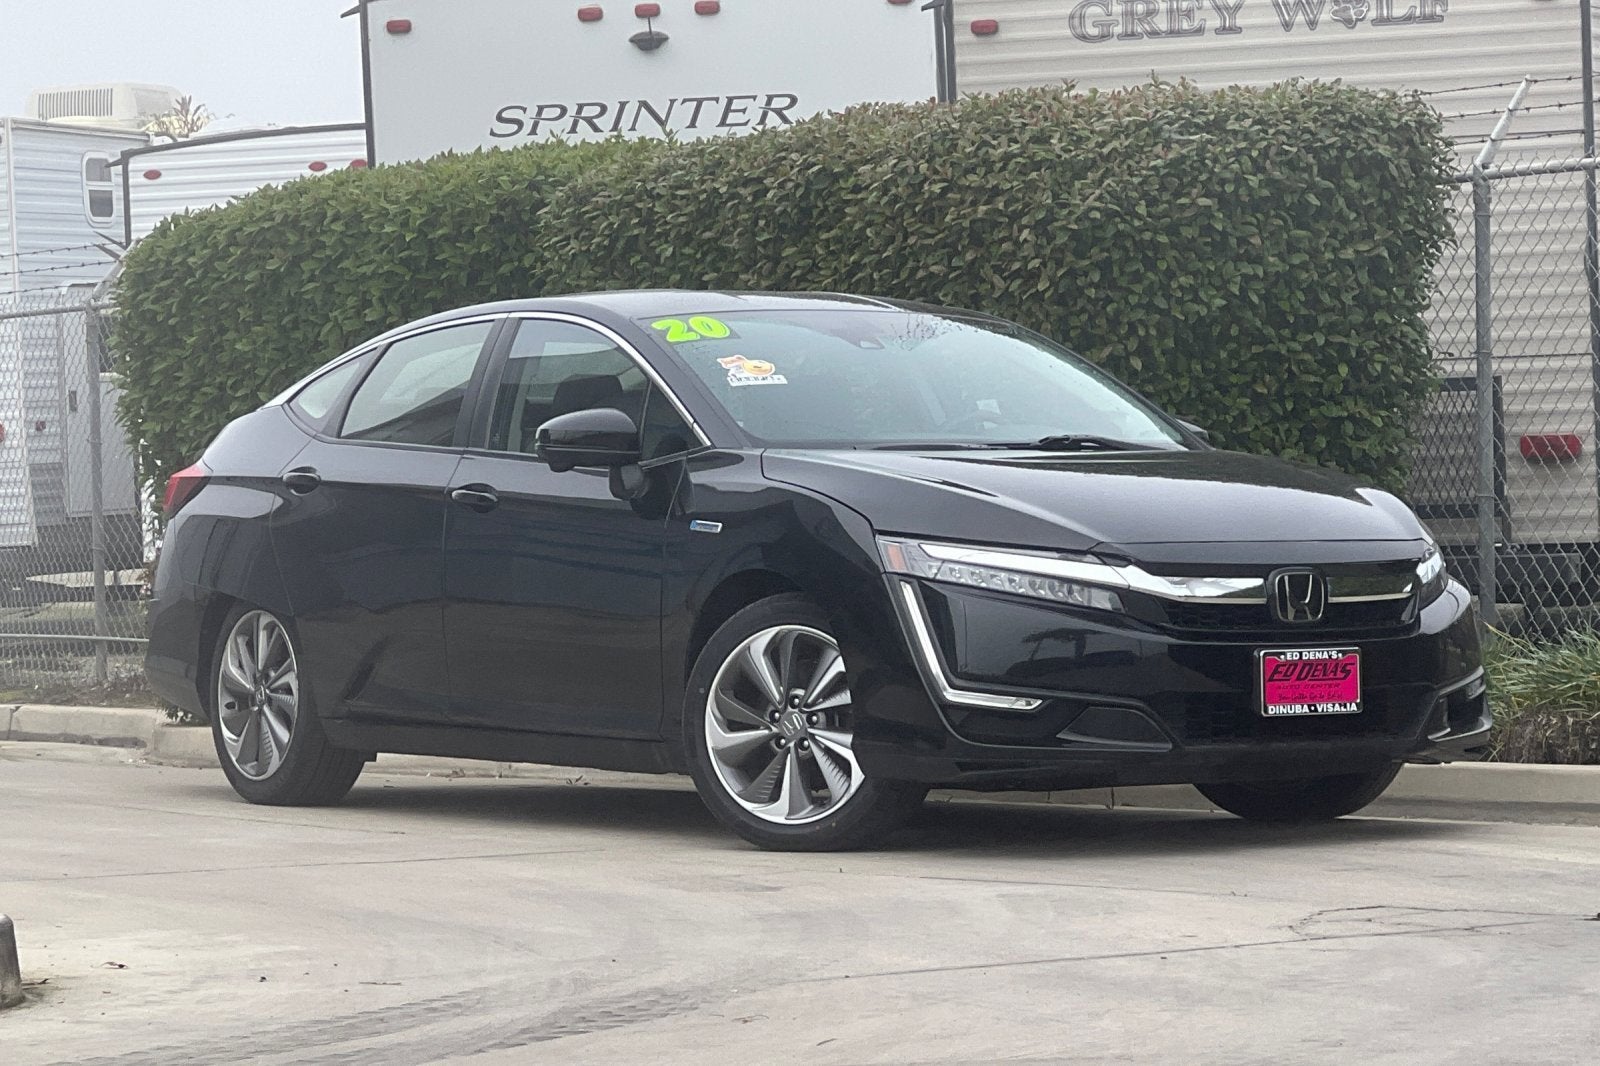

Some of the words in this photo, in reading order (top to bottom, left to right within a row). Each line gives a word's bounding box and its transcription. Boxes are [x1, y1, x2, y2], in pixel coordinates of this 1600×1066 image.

[1068, 0, 1243, 44] GREY
[489, 93, 799, 138] SPRINTER
[651, 316, 730, 342] 20
[1286, 652, 1300, 660] ED
[1302, 650, 1338, 660] DENA'S
[1268, 662, 1299, 682] ED
[1268, 704, 1310, 714] DINUBA
[1316, 702, 1358, 712] VISALIA
